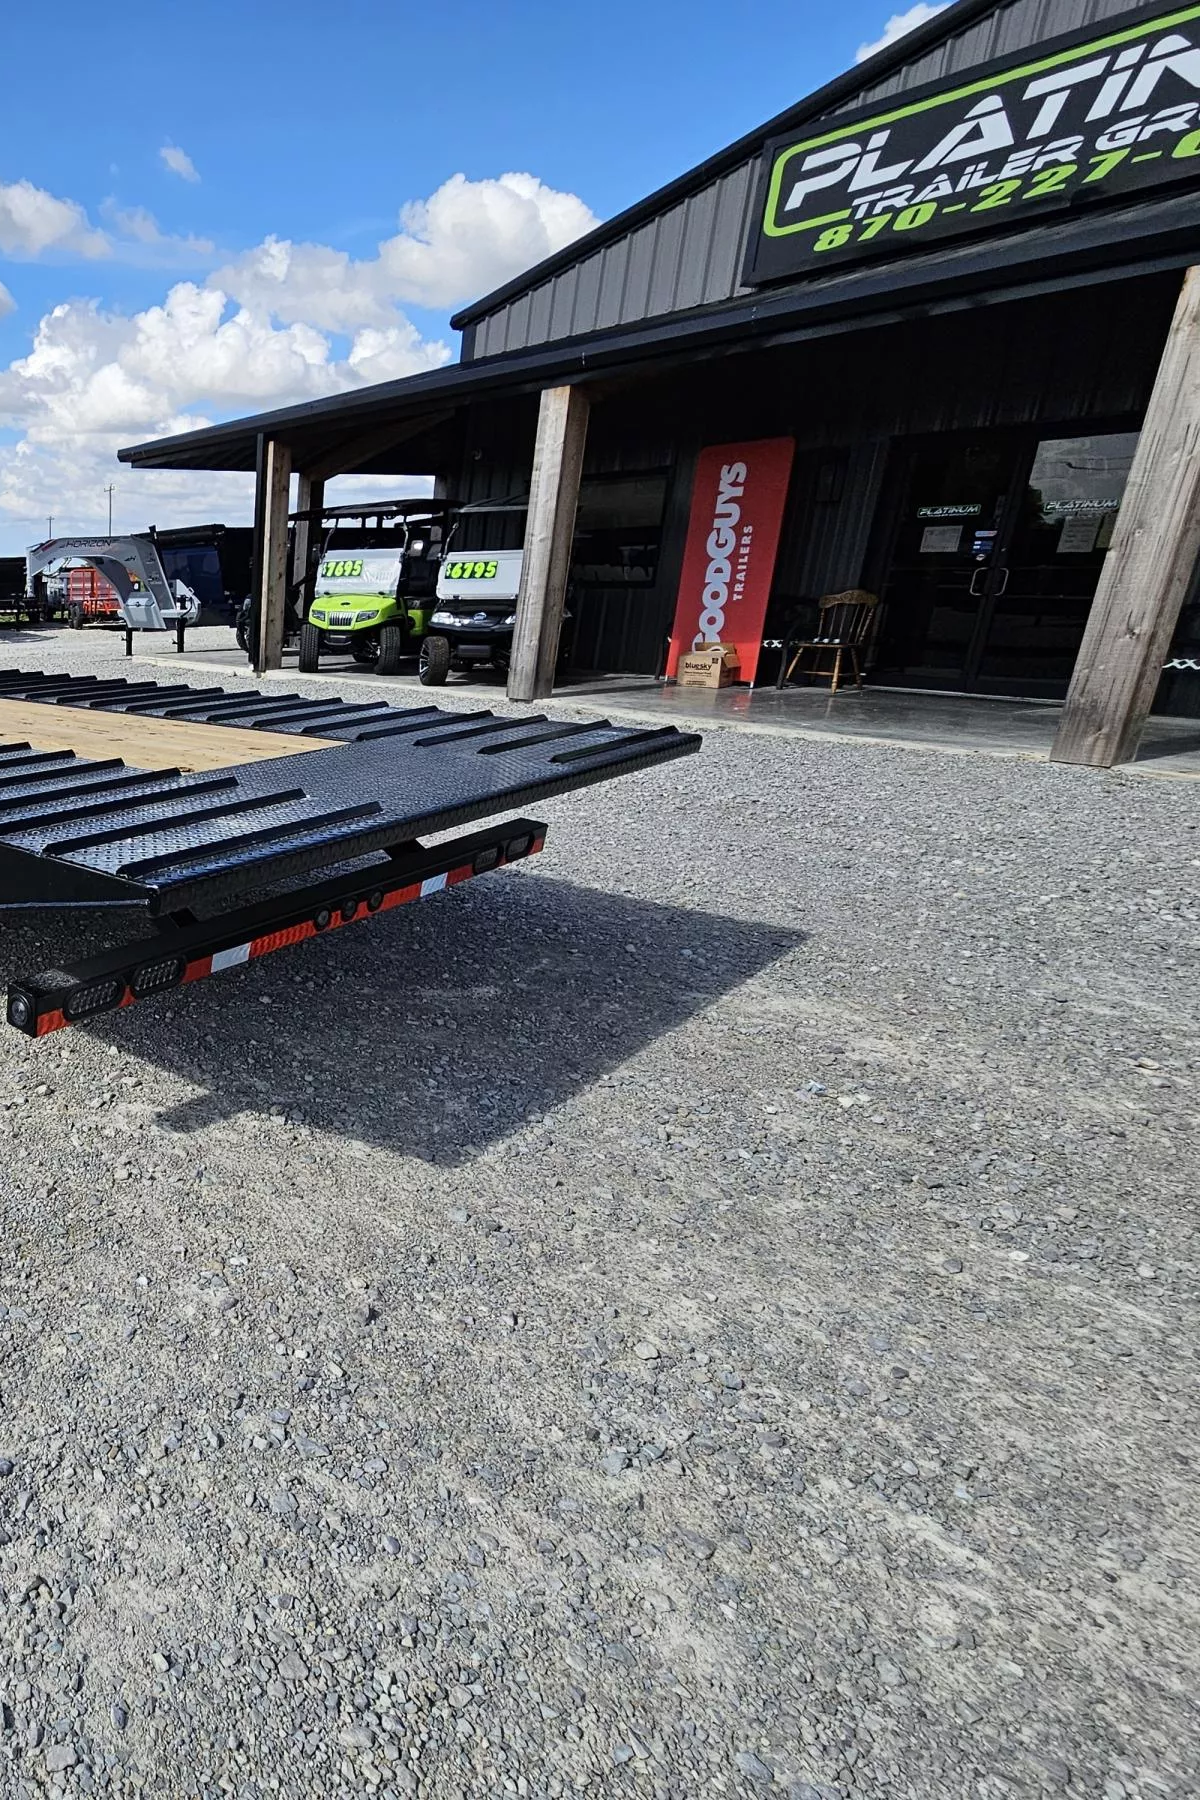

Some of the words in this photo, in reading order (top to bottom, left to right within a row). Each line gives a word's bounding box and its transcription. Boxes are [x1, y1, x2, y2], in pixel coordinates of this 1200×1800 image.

[852, 135, 1084, 219] TRAILER
[1095, 102, 1200, 150] GR
[920, 505, 978, 515] PLATINUM
[1047, 499, 1117, 509] PLATINUM
[65, 539, 112, 548] HORIZON
[323, 560, 363, 577] $7695
[732, 525, 752, 601] TRAILERS
[446, 562, 497, 579] $6795
[685, 662, 712, 671] bluesky
